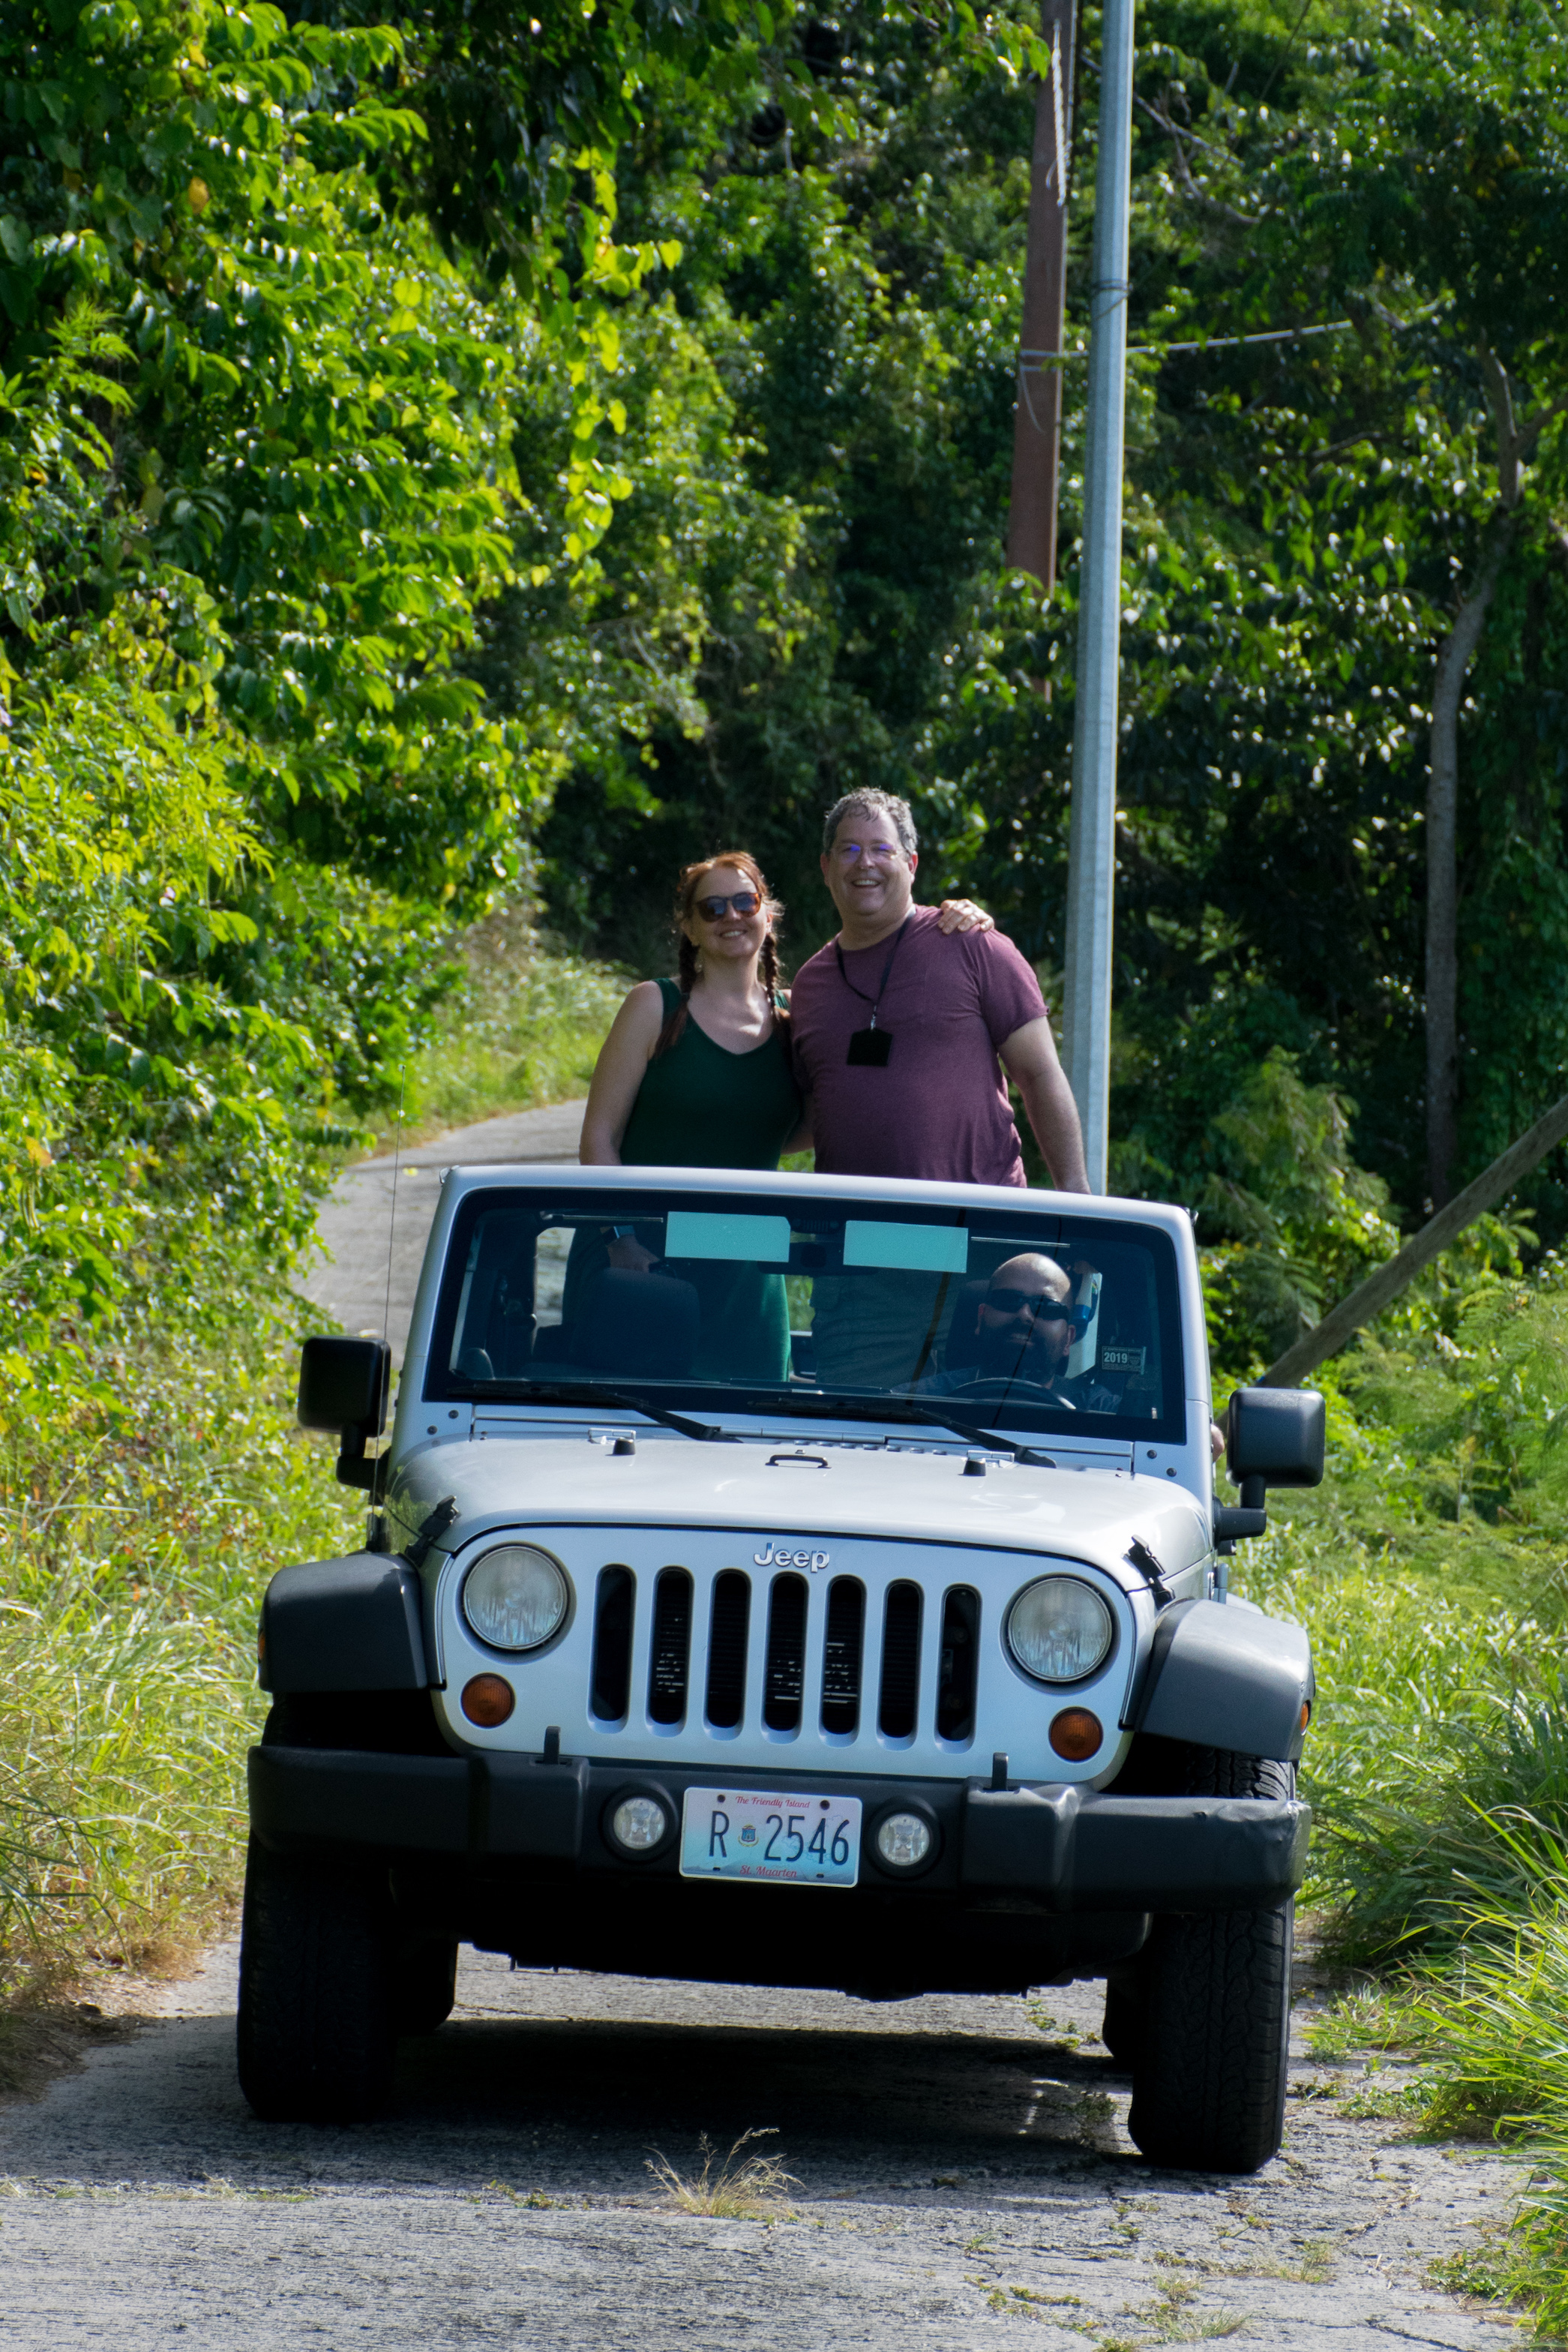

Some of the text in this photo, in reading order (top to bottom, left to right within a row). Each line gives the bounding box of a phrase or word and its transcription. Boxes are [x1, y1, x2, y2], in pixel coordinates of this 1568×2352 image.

[1104, 1352, 1128, 1364] 2019
[754, 1542, 829, 1573] Jeep
[736, 1796, 810, 1808] The Friendly Island
[709, 1810, 850, 1865] R 2546
[756, 1866, 797, 1878] Maarten
